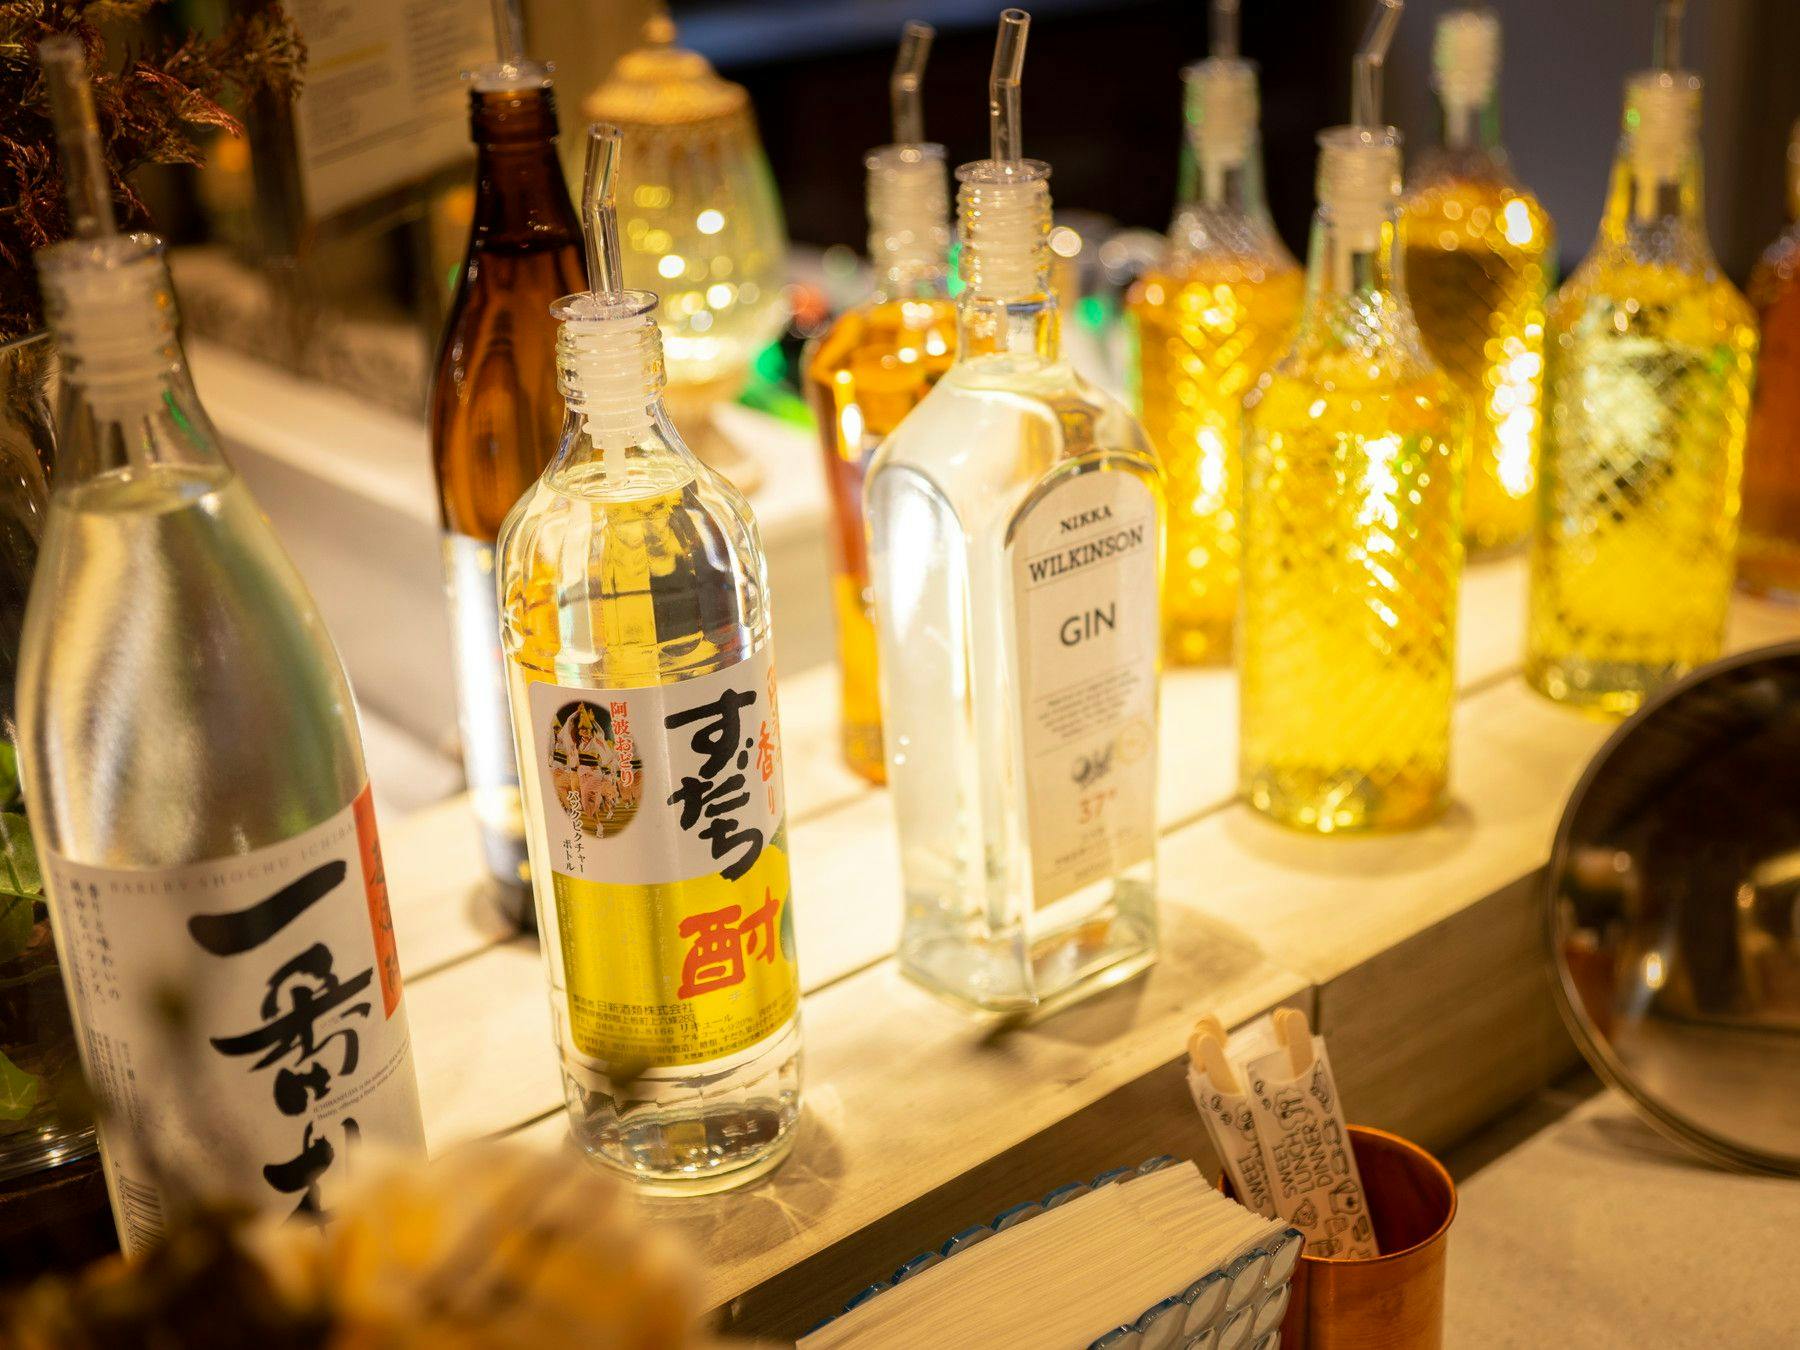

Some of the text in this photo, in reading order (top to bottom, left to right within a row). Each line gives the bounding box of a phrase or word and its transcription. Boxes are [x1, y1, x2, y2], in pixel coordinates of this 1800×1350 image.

[1060, 505, 1112, 534] NIKKA
[1029, 525, 1144, 583] WILKINSON
[1060, 602, 1116, 646] GIN
[609, 701, 634, 787] 阿波おどり
[1272, 1143, 1299, 1200] SWEET
[1283, 1131, 1315, 1195] LUNCH
[1302, 1119, 1333, 1188] DINNER
[1238, 1158, 1265, 1209] SWEET
